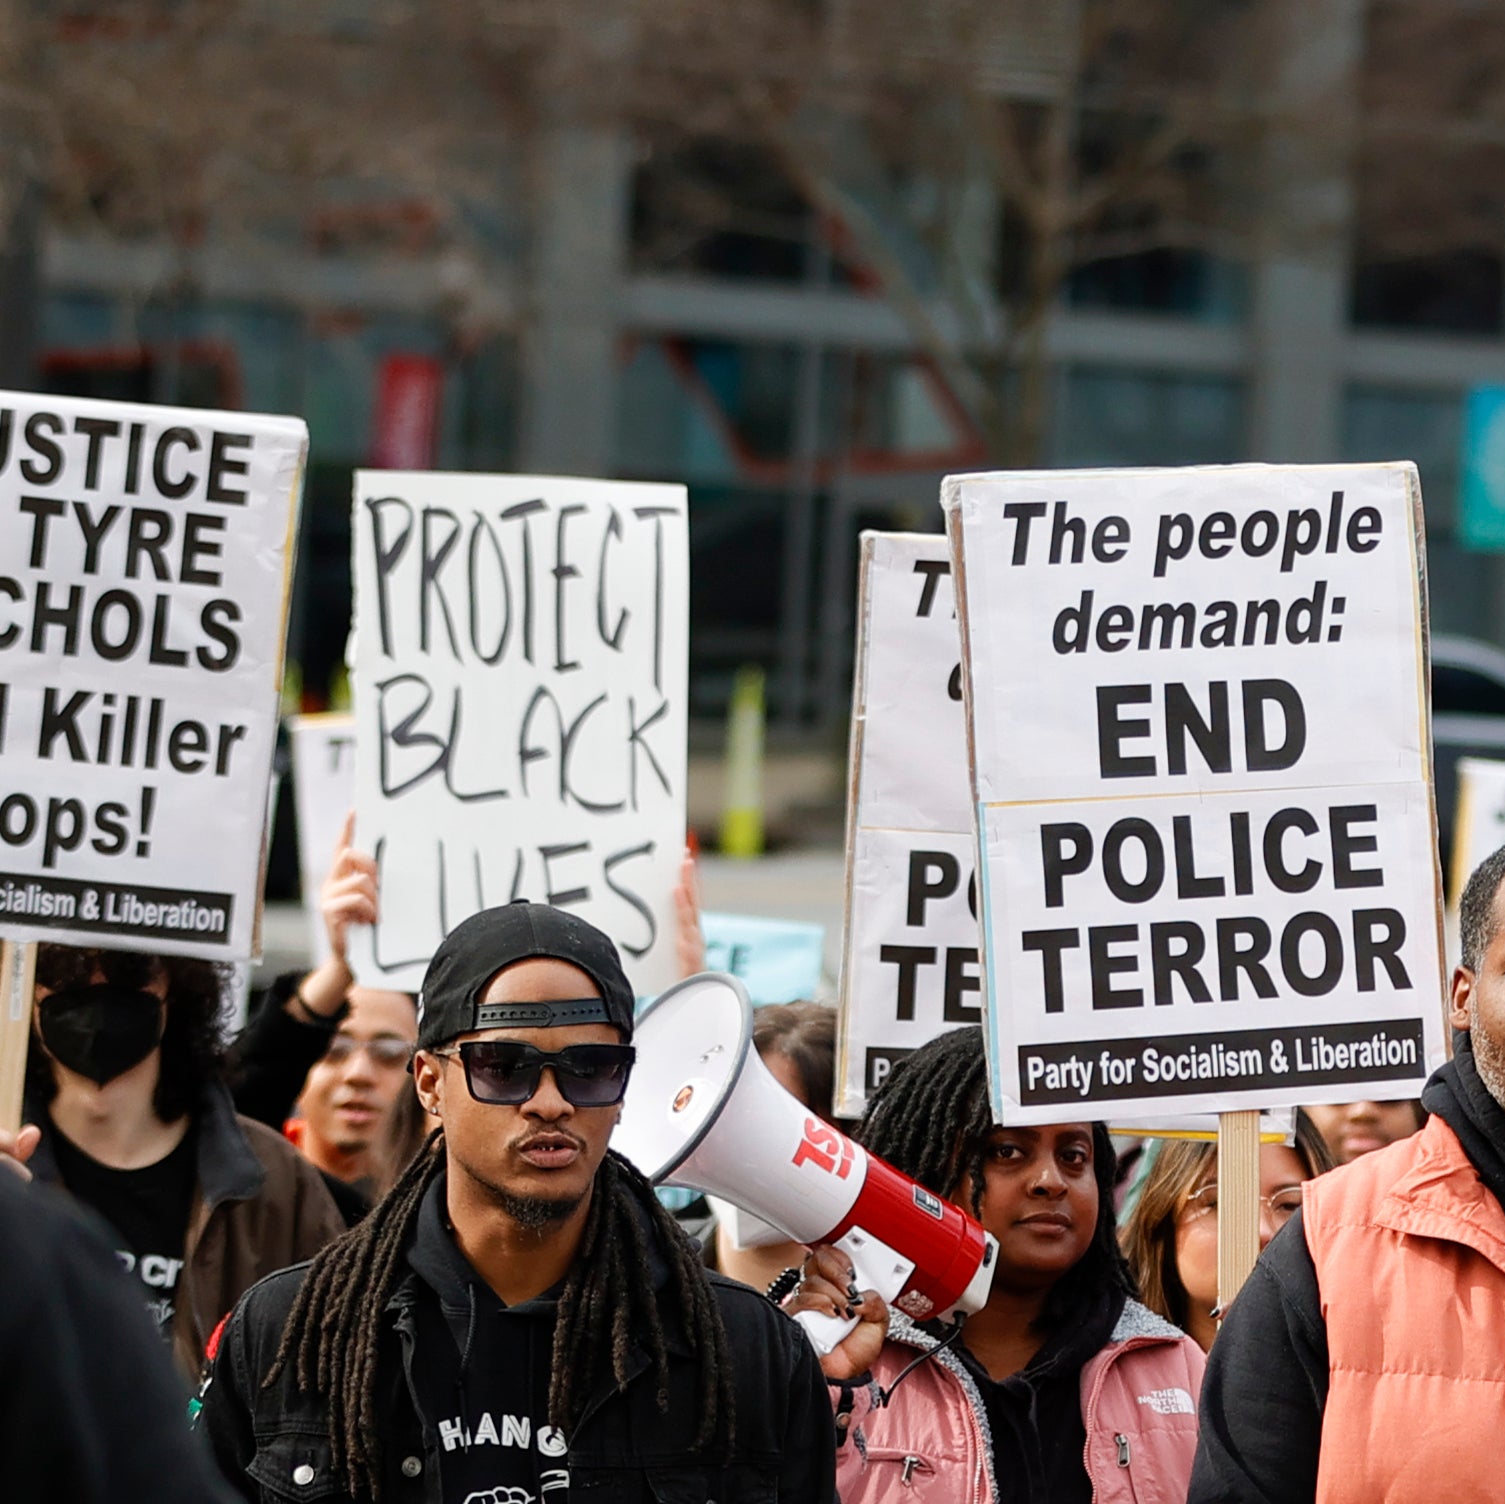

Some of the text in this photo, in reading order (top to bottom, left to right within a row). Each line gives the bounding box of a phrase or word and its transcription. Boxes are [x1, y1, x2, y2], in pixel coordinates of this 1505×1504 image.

[0, 409, 255, 507] STICE
[20, 496, 229, 588] TYRE
[1002, 490, 1383, 578] The people
[364, 496, 681, 693] PROTECT
[1051, 580, 1347, 655] demand:
[37, 686, 249, 778] Killer
[374, 672, 672, 814] BLACK
[1095, 677, 1307, 780] END
[1039, 803, 1385, 909] POLICE
[79, 890, 99, 921] &
[105, 892, 226, 933] Liberation
[1020, 906, 1413, 1014] TERROR
[1026, 1035, 1417, 1097] Party for Socialism & Liberation
[438, 1412, 568, 1457] HANG
